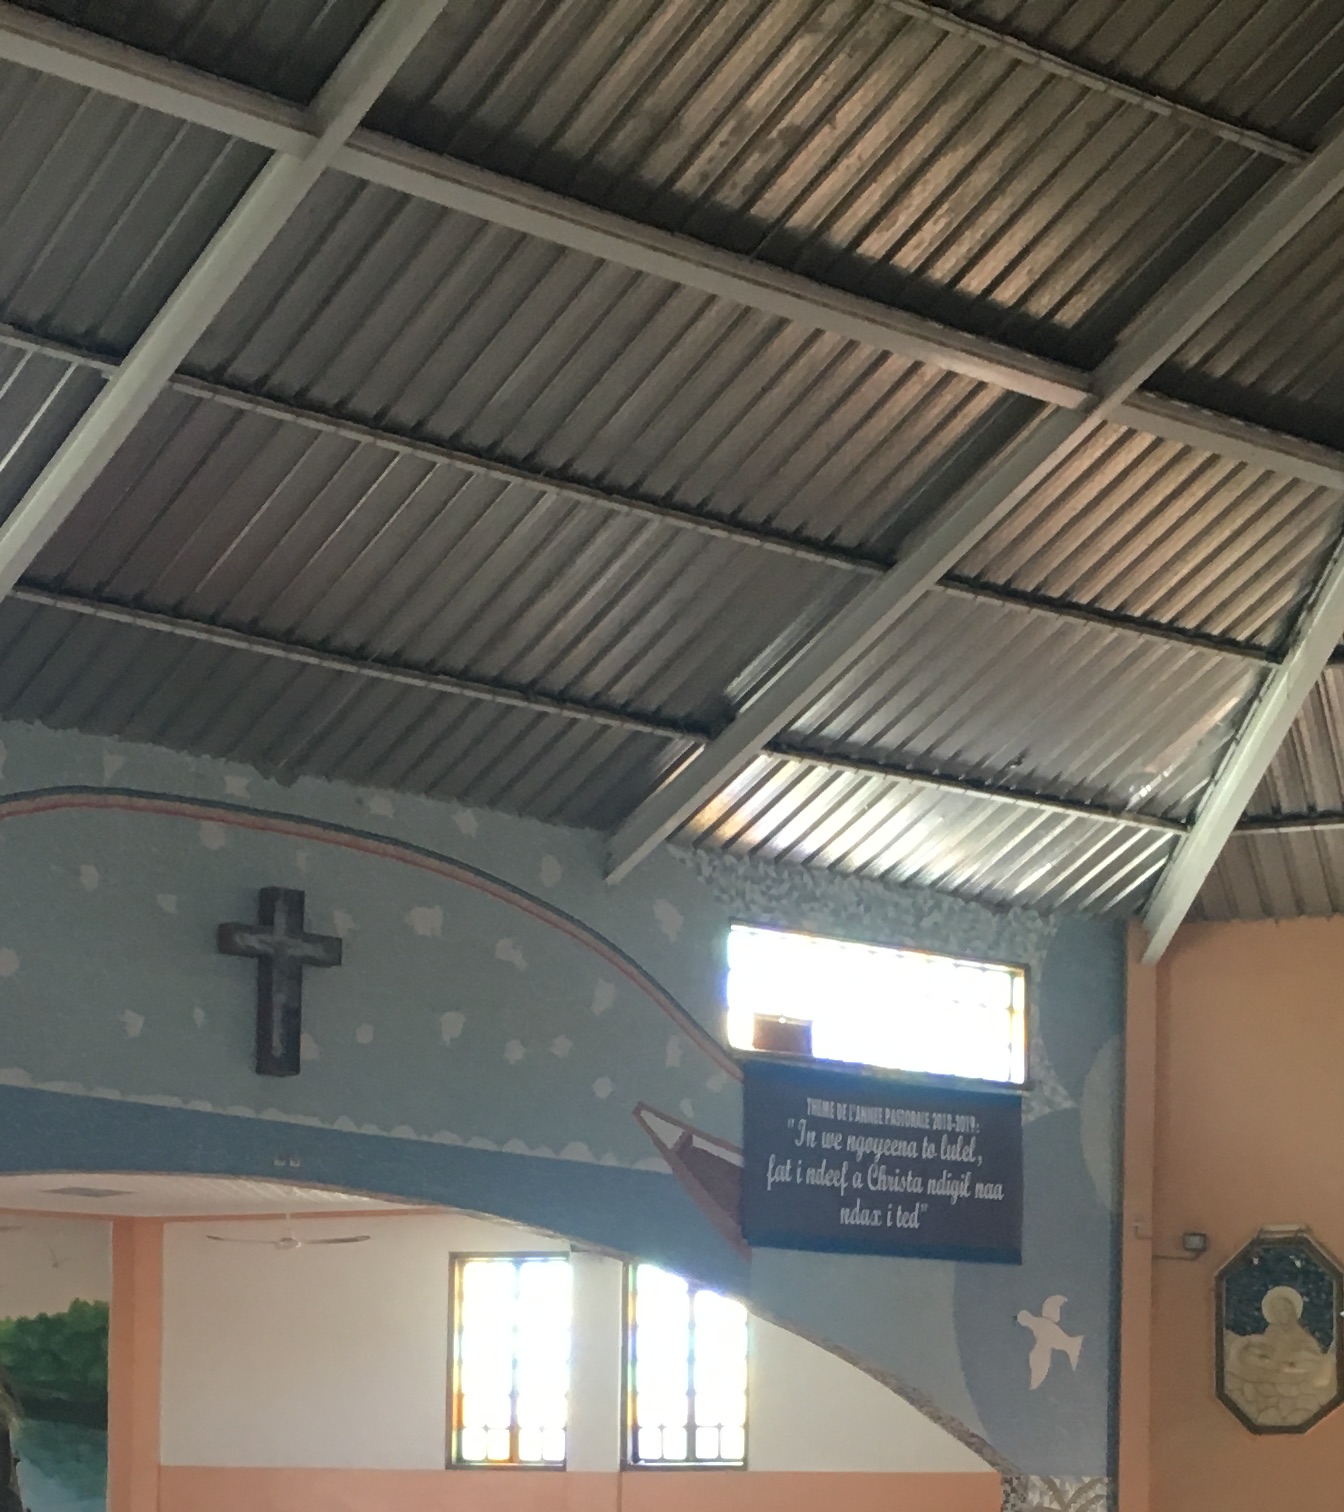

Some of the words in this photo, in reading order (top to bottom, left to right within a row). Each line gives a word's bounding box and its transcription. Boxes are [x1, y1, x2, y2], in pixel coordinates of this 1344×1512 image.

[836, 1102, 847, 1121] DE
[884, 1107, 930, 1129] PASTORALE
[821, 1131, 842, 1150] we
[921, 1135, 938, 1159] to
[766, 1153, 792, 1191] fat
[796, 1159, 803, 1185] i
[805, 1158, 849, 1196] ndeef
[852, 1171, 863, 1189] a
[974, 1182, 1005, 1200] naa
[839, 1197, 882, 1226] ndax
[886, 1203, 894, 1227] i
